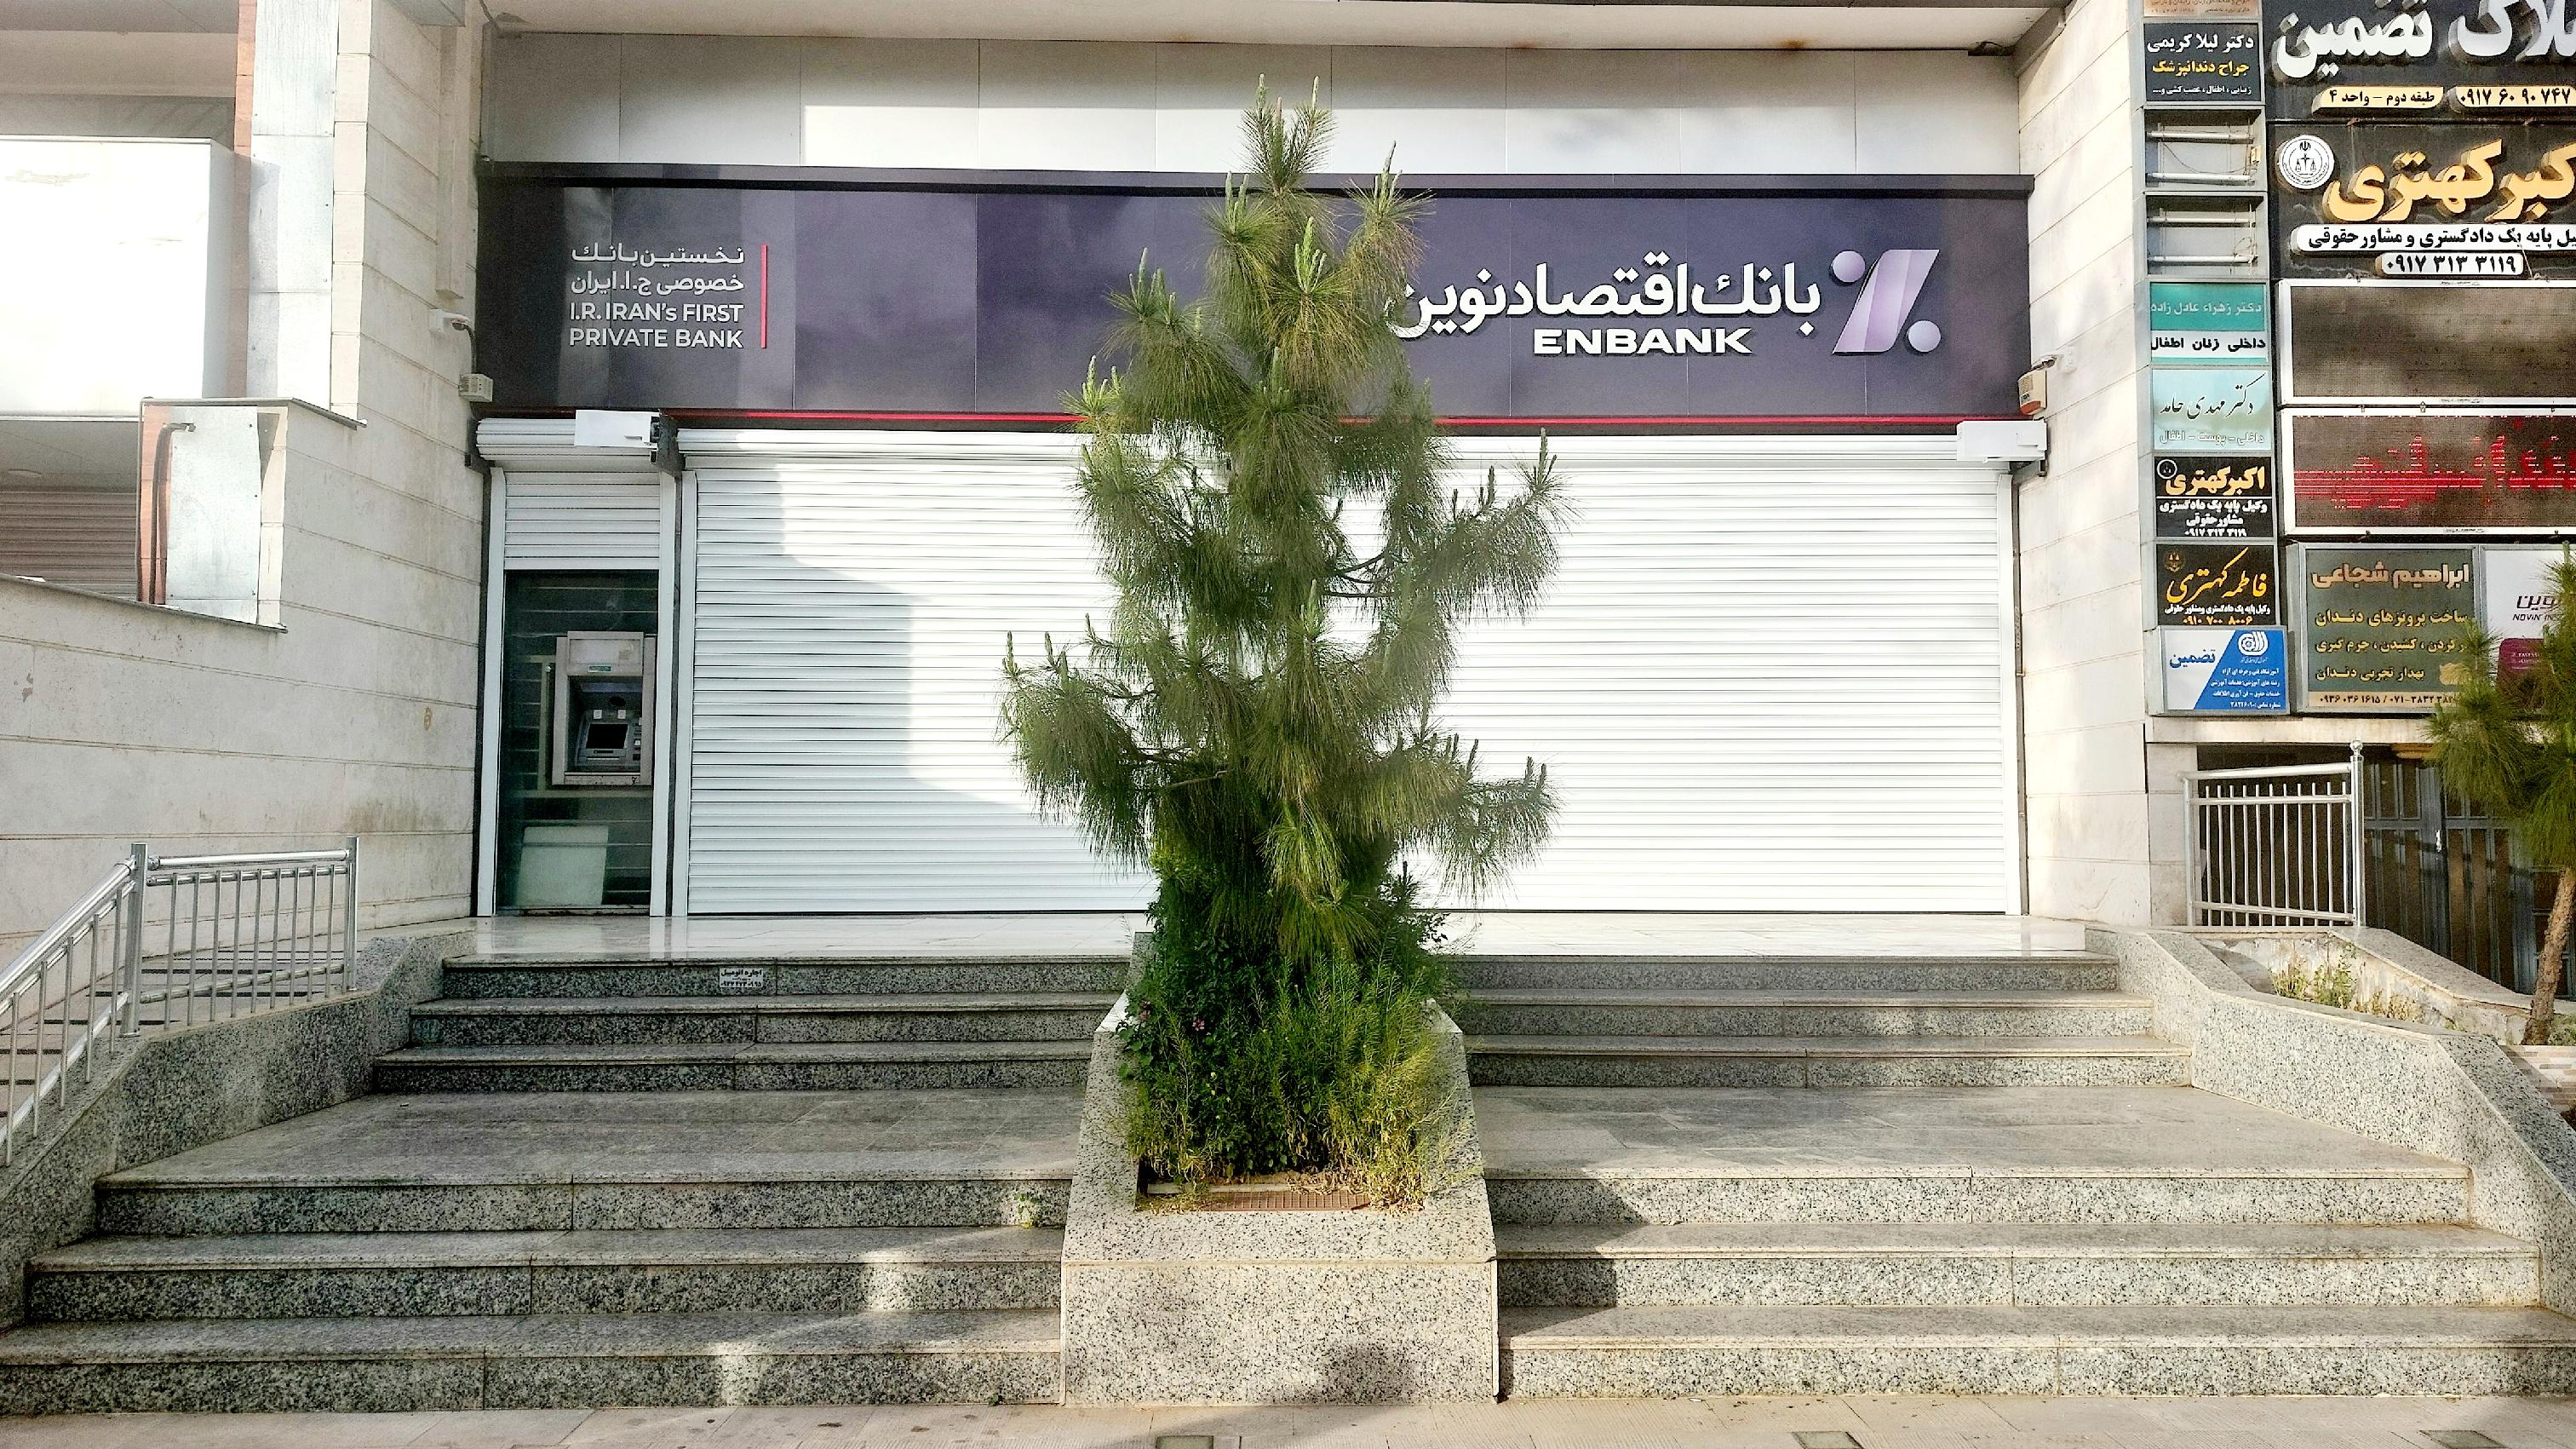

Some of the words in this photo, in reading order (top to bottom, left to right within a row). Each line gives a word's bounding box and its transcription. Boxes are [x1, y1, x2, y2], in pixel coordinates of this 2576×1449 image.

[2147, 34, 2193, 52] کریمی
[2195, 33, 2218, 52] لیلا
[2223, 34, 2255, 53] دکتر
[2152, 60, 2216, 77] دندانپزشک
[2218, 60, 2250, 77] جراح
[2329, 89, 2338, 102] ۴
[2341, 90, 2370, 106] واحد
[2386, 92, 2407, 106] دوم
[2410, 90, 2435, 106] طبقه
[2460, 89, 2492, 103] ۰۹۱۷
[2499, 89, 2515, 102] ۶۰
[2521, 89, 2536, 103] ۹۰
[2540, 89, 2571, 103] ۷۴۷
[2327, 139, 2502, 221] کهتری
[2309, 228, 2359, 249] حقوقی
[2362, 228, 2404, 249] مشاور
[2407, 234, 2415, 247] و
[2419, 227, 2495, 248] دادگستری
[2498, 226, 2522, 248] یک
[2527, 227, 2552, 248] پایه
[640, 245, 745, 267] نخستین
[2386, 256, 2427, 273] ۰۹۱۷
[2433, 256, 2468, 273] ۳۱۳
[2475, 256, 2516, 273] ۳۱۱۹
[656, 273, 745, 296] خصوصی
[570, 302, 602, 321] I.R.
[605, 302, 678, 321] IRAN's
[683, 304, 744, 323] FIRST
[2151, 302, 2172, 315] زاده
[2173, 302, 2200, 315] عادل
[2235, 302, 2262, 315] دکتر
[570, 328, 668, 348] PRIVATE
[675, 330, 743, 348] BANK
[1533, 328, 1753, 356] ENBANK
[2151, 337, 2184, 350] اطفال
[2192, 338, 2220, 351] زنان
[2228, 337, 2266, 352] داخلی
[2224, 372, 2266, 418] دکتر
[2160, 394, 2184, 414] حامد
[2187, 396, 2225, 419] مهدی
[2160, 430, 2185, 445] اطفال
[2199, 432, 2226, 447] پوست
[2237, 431, 2264, 446] داخلی
[2166, 466, 2231, 496] کهتری
[2222, 465, 2265, 496] اکبر
[2160, 499, 2206, 514] دادگستری
[2207, 499, 2223, 513] یک
[2224, 499, 2240, 514] پایه
[2241, 499, 2268, 514] وکیل
[2186, 513, 2217, 527] حقوقی
[2216, 514, 2244, 527] مشاور
[2184, 528, 2206, 537] ۰۹۱۷
[2206, 528, 2225, 537] ۳۱۳
[2166, 546, 2249, 606] کهتری
[2311, 561, 2390, 589] شجاعی
[2393, 563, 2470, 589] ابراهیم
[2221, 570, 2267, 598] فاطمه
[2206, 605, 2234, 614] دادگستری
[2256, 604, 2271, 614] وکیل
[2430, 609, 2468, 624] ساخت
[2315, 609, 2364, 627] دندان
[2368, 609, 2426, 628] پروتزهای
[2347, 641, 2370, 653] جرم
[2169, 648, 2216, 669] تضمین
[2315, 666, 2357, 681] دندان
[2360, 667, 2395, 681] تجربی
[2398, 666, 2424, 681] بهدار
[2320, 695, 2341, 704] ۰۹۳۶
[2343, 695, 2359, 704] ۰۳۶
[2361, 695, 2381, 704] ۱۶۱۵
